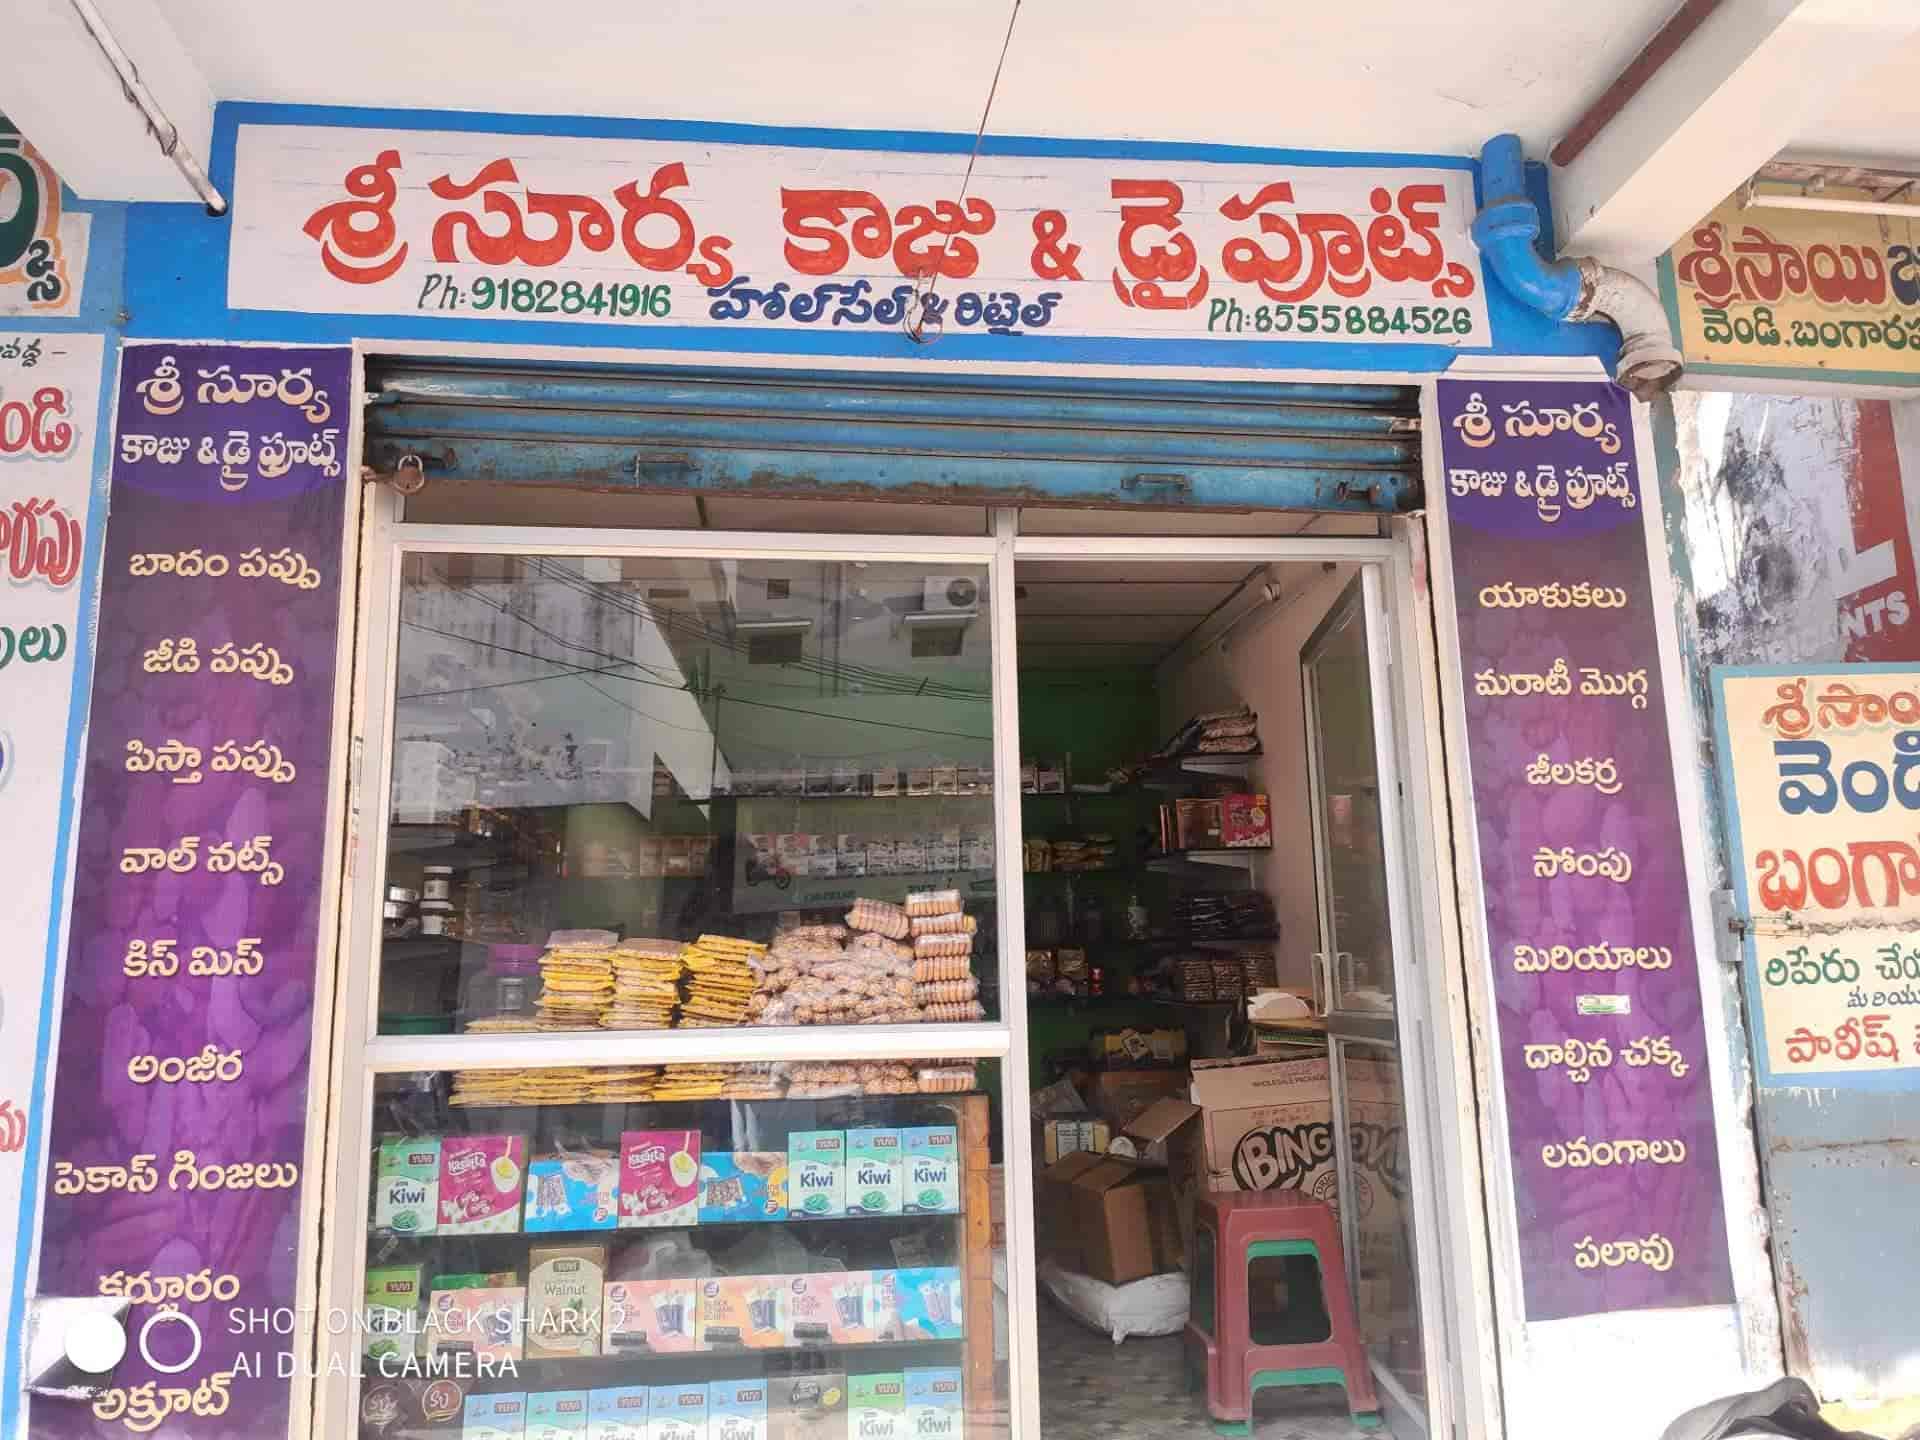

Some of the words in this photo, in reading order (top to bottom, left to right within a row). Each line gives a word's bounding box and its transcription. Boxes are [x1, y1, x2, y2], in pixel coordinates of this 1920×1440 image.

[302, 150, 408, 284] శ్రీ
[428, 158, 734, 287] సూర్య
[781, 187, 995, 279] కాజు
[1031, 210, 1085, 281] &
[1112, 179, 1210, 310] డ్రై
[954, 292, 1063, 336] రిటైల్
[136, 355, 185, 416] శ్రీ
[196, 364, 332, 424] సూర్య
[0, 386, 73, 454] ండి
[1452, 391, 1497, 449] శ్రీ
[1501, 399, 1623, 456] సూర్య
[120, 433, 191, 465] కాజు
[1448, 467, 1509, 498] కాజు
[129, 549, 230, 578] బాదం
[238, 547, 321, 590] పప్పు
[143, 637, 201, 674] జీడి
[209, 642, 294, 687] పప్పు
[1474, 657, 1573, 698] మరాటీ
[1579, 667, 1649, 711] మొగ్గ
[124, 738, 203, 785] పిస్తా
[211, 740, 297, 785] పప్పు
[1525, 752, 1623, 795] జీలకర్ర
[119, 836, 201, 874] వాల్
[206, 835, 285, 887] నట్స్
[1532, 846, 1633, 883] సోంపు
[1755, 836, 1920, 912] బంగా
[122, 938, 180, 978] కిస్
[188, 937, 265, 978] మిస్
[1512, 940, 1674, 974] మిరియాలు
[1764, 945, 1861, 986] రిపేరు
[127, 1044, 243, 1084] అంజీర
[1524, 1037, 1614, 1084] దాల్చిన
[1620, 1035, 1690, 1078] చక్క
[168, 1149, 299, 1192] గింజలు
[1241, 1126, 1333, 1191] BING
[1541, 1135, 1687, 1169] లవంగాలు
[389, 1186, 426, 1205] Kiwi
[800, 1171, 833, 1187] Kiwi
[858, 1168, 891, 1185] Kiwi
[914, 1166, 947, 1183] Kiwi
[1573, 1233, 1675, 1272] పలావు
[544, 1281, 585, 1296] Walnut
[91, 1371, 235, 1433] అక్రూట్
[858, 1418, 895, 1437] Kiwi
[917, 1415, 952, 1434] Kiwi
